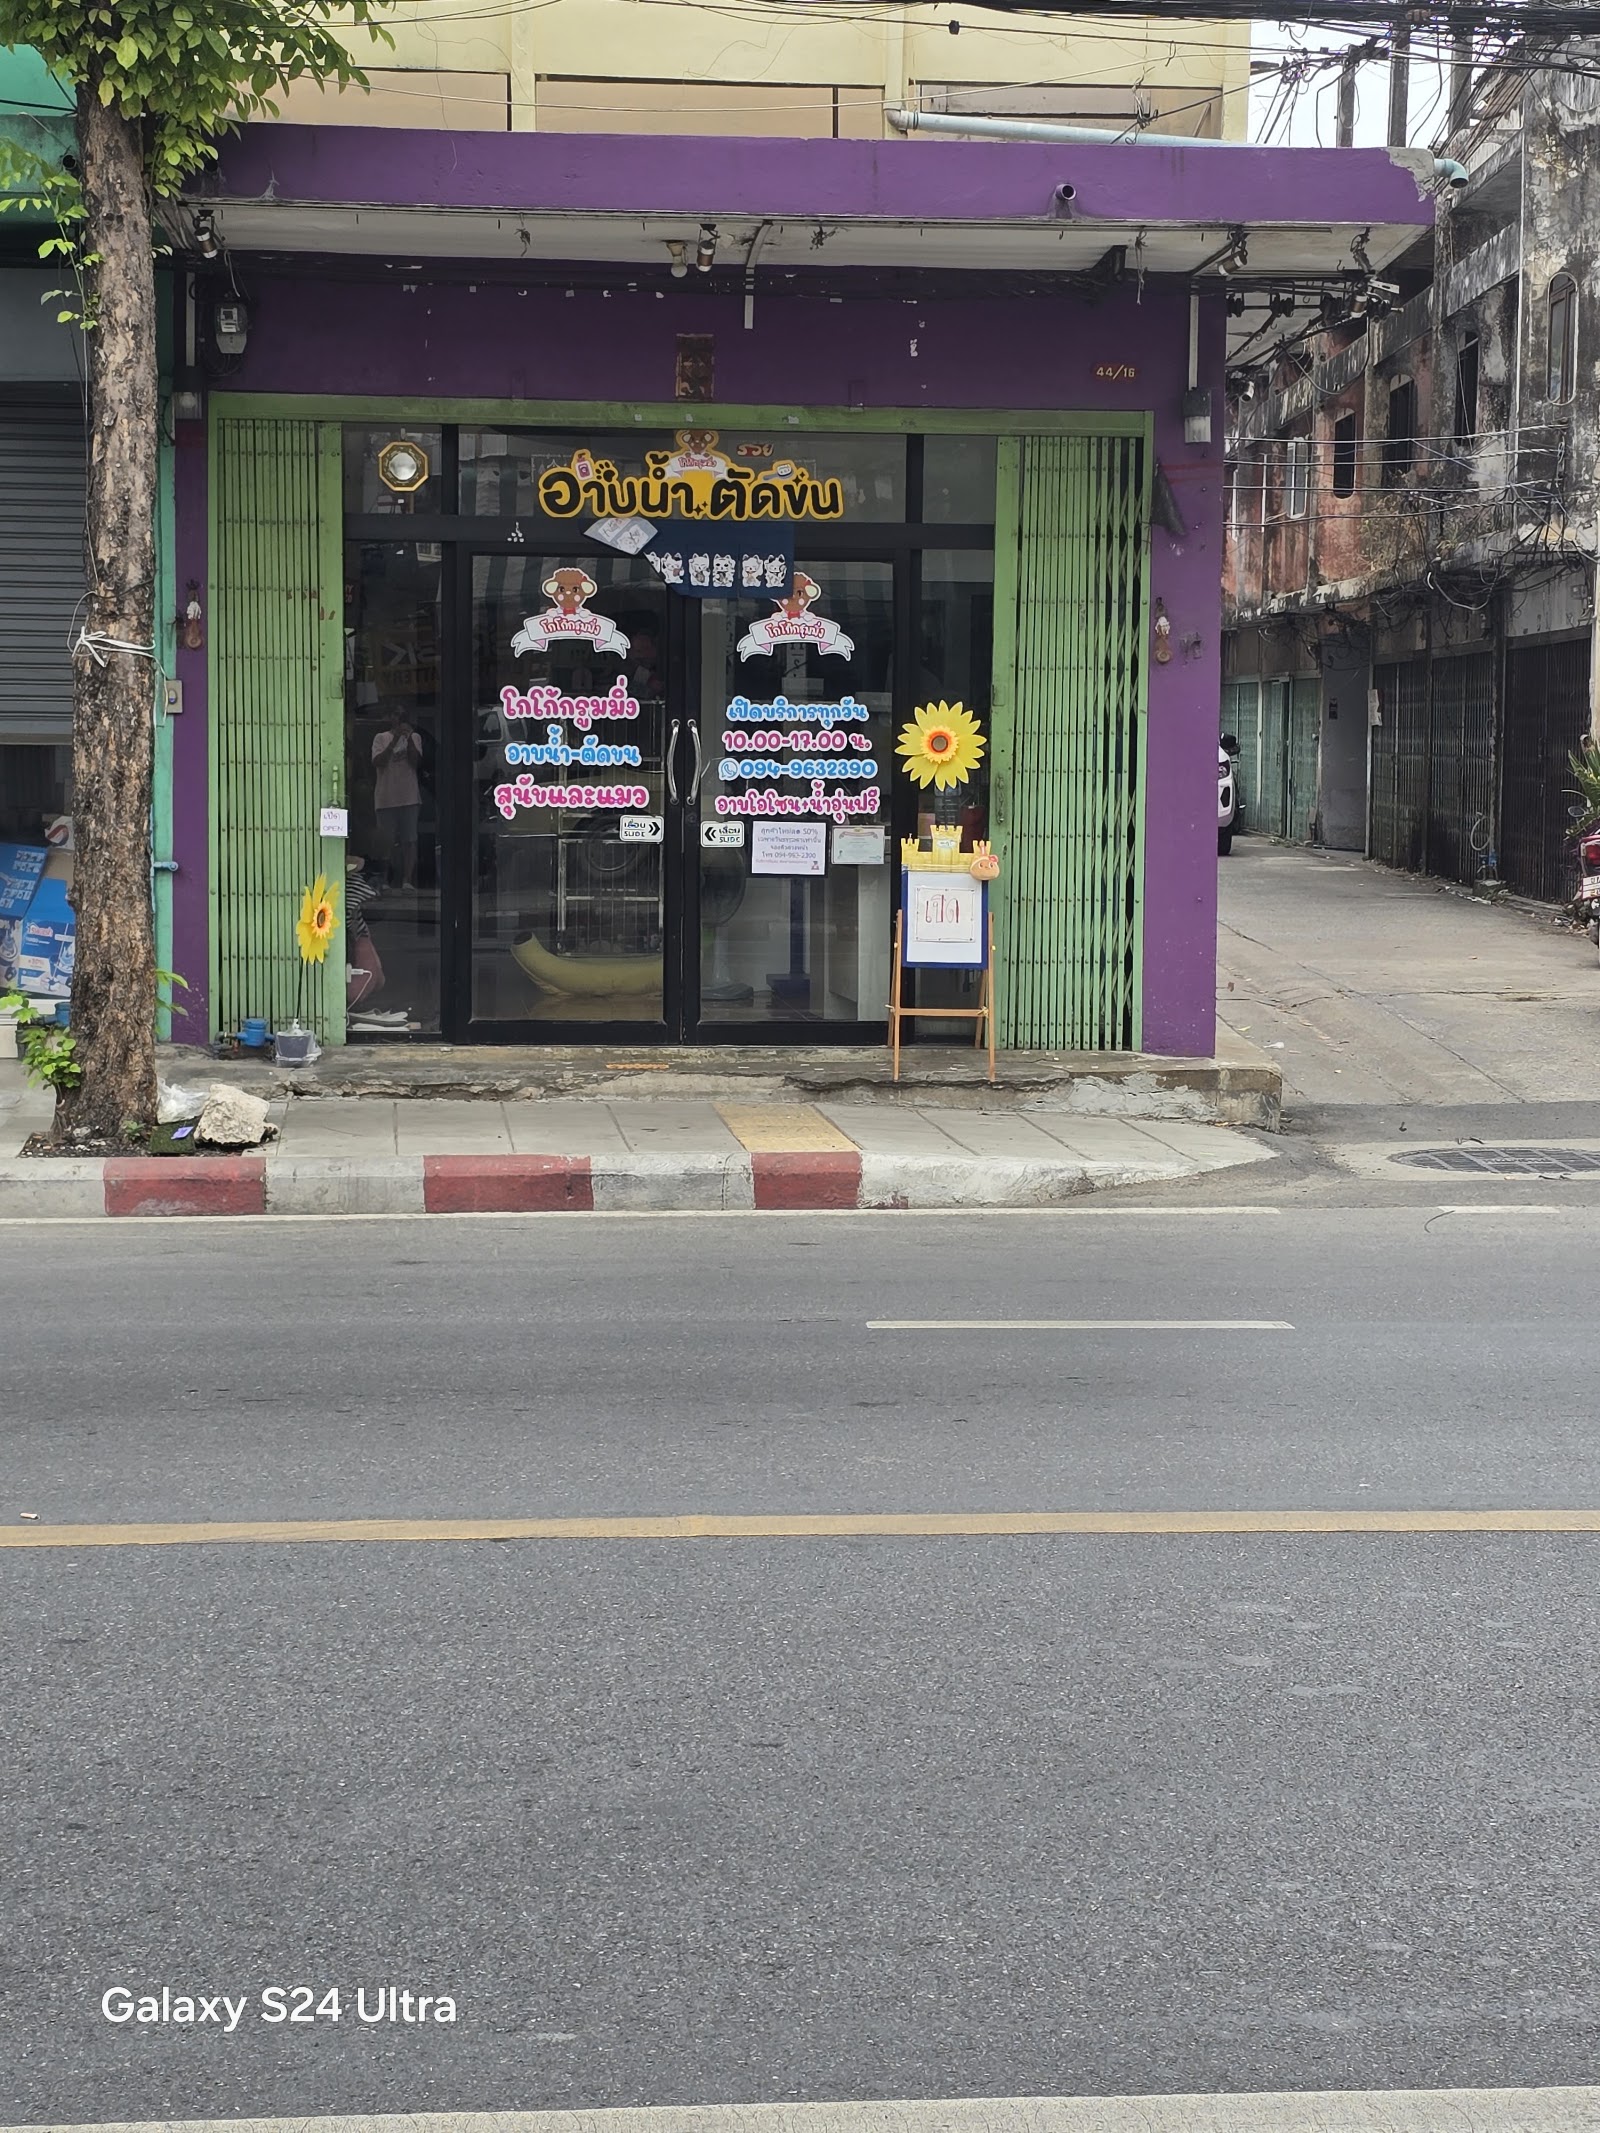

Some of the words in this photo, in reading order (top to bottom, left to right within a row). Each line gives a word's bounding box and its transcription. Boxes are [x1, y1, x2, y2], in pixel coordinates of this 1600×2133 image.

[1096, 364, 1136, 380] 44/16
[542, 453, 695, 515] อาบน้ำ
[709, 467, 841, 519] ตัดขน
[501, 676, 638, 729] โกโก้กรูมมิ่ง
[727, 697, 868, 728] เปิดบริการทุกวัน
[506, 725, 640, 765] อาบน้ำ-ตัดขน
[723, 732, 845, 750] 10.00-17.00
[850, 734, 872, 749] น.
[740, 761, 876, 777] 094-9632390
[495, 775, 649, 819] สุนัขและแมว
[925, 893, 960, 924] เปิด
